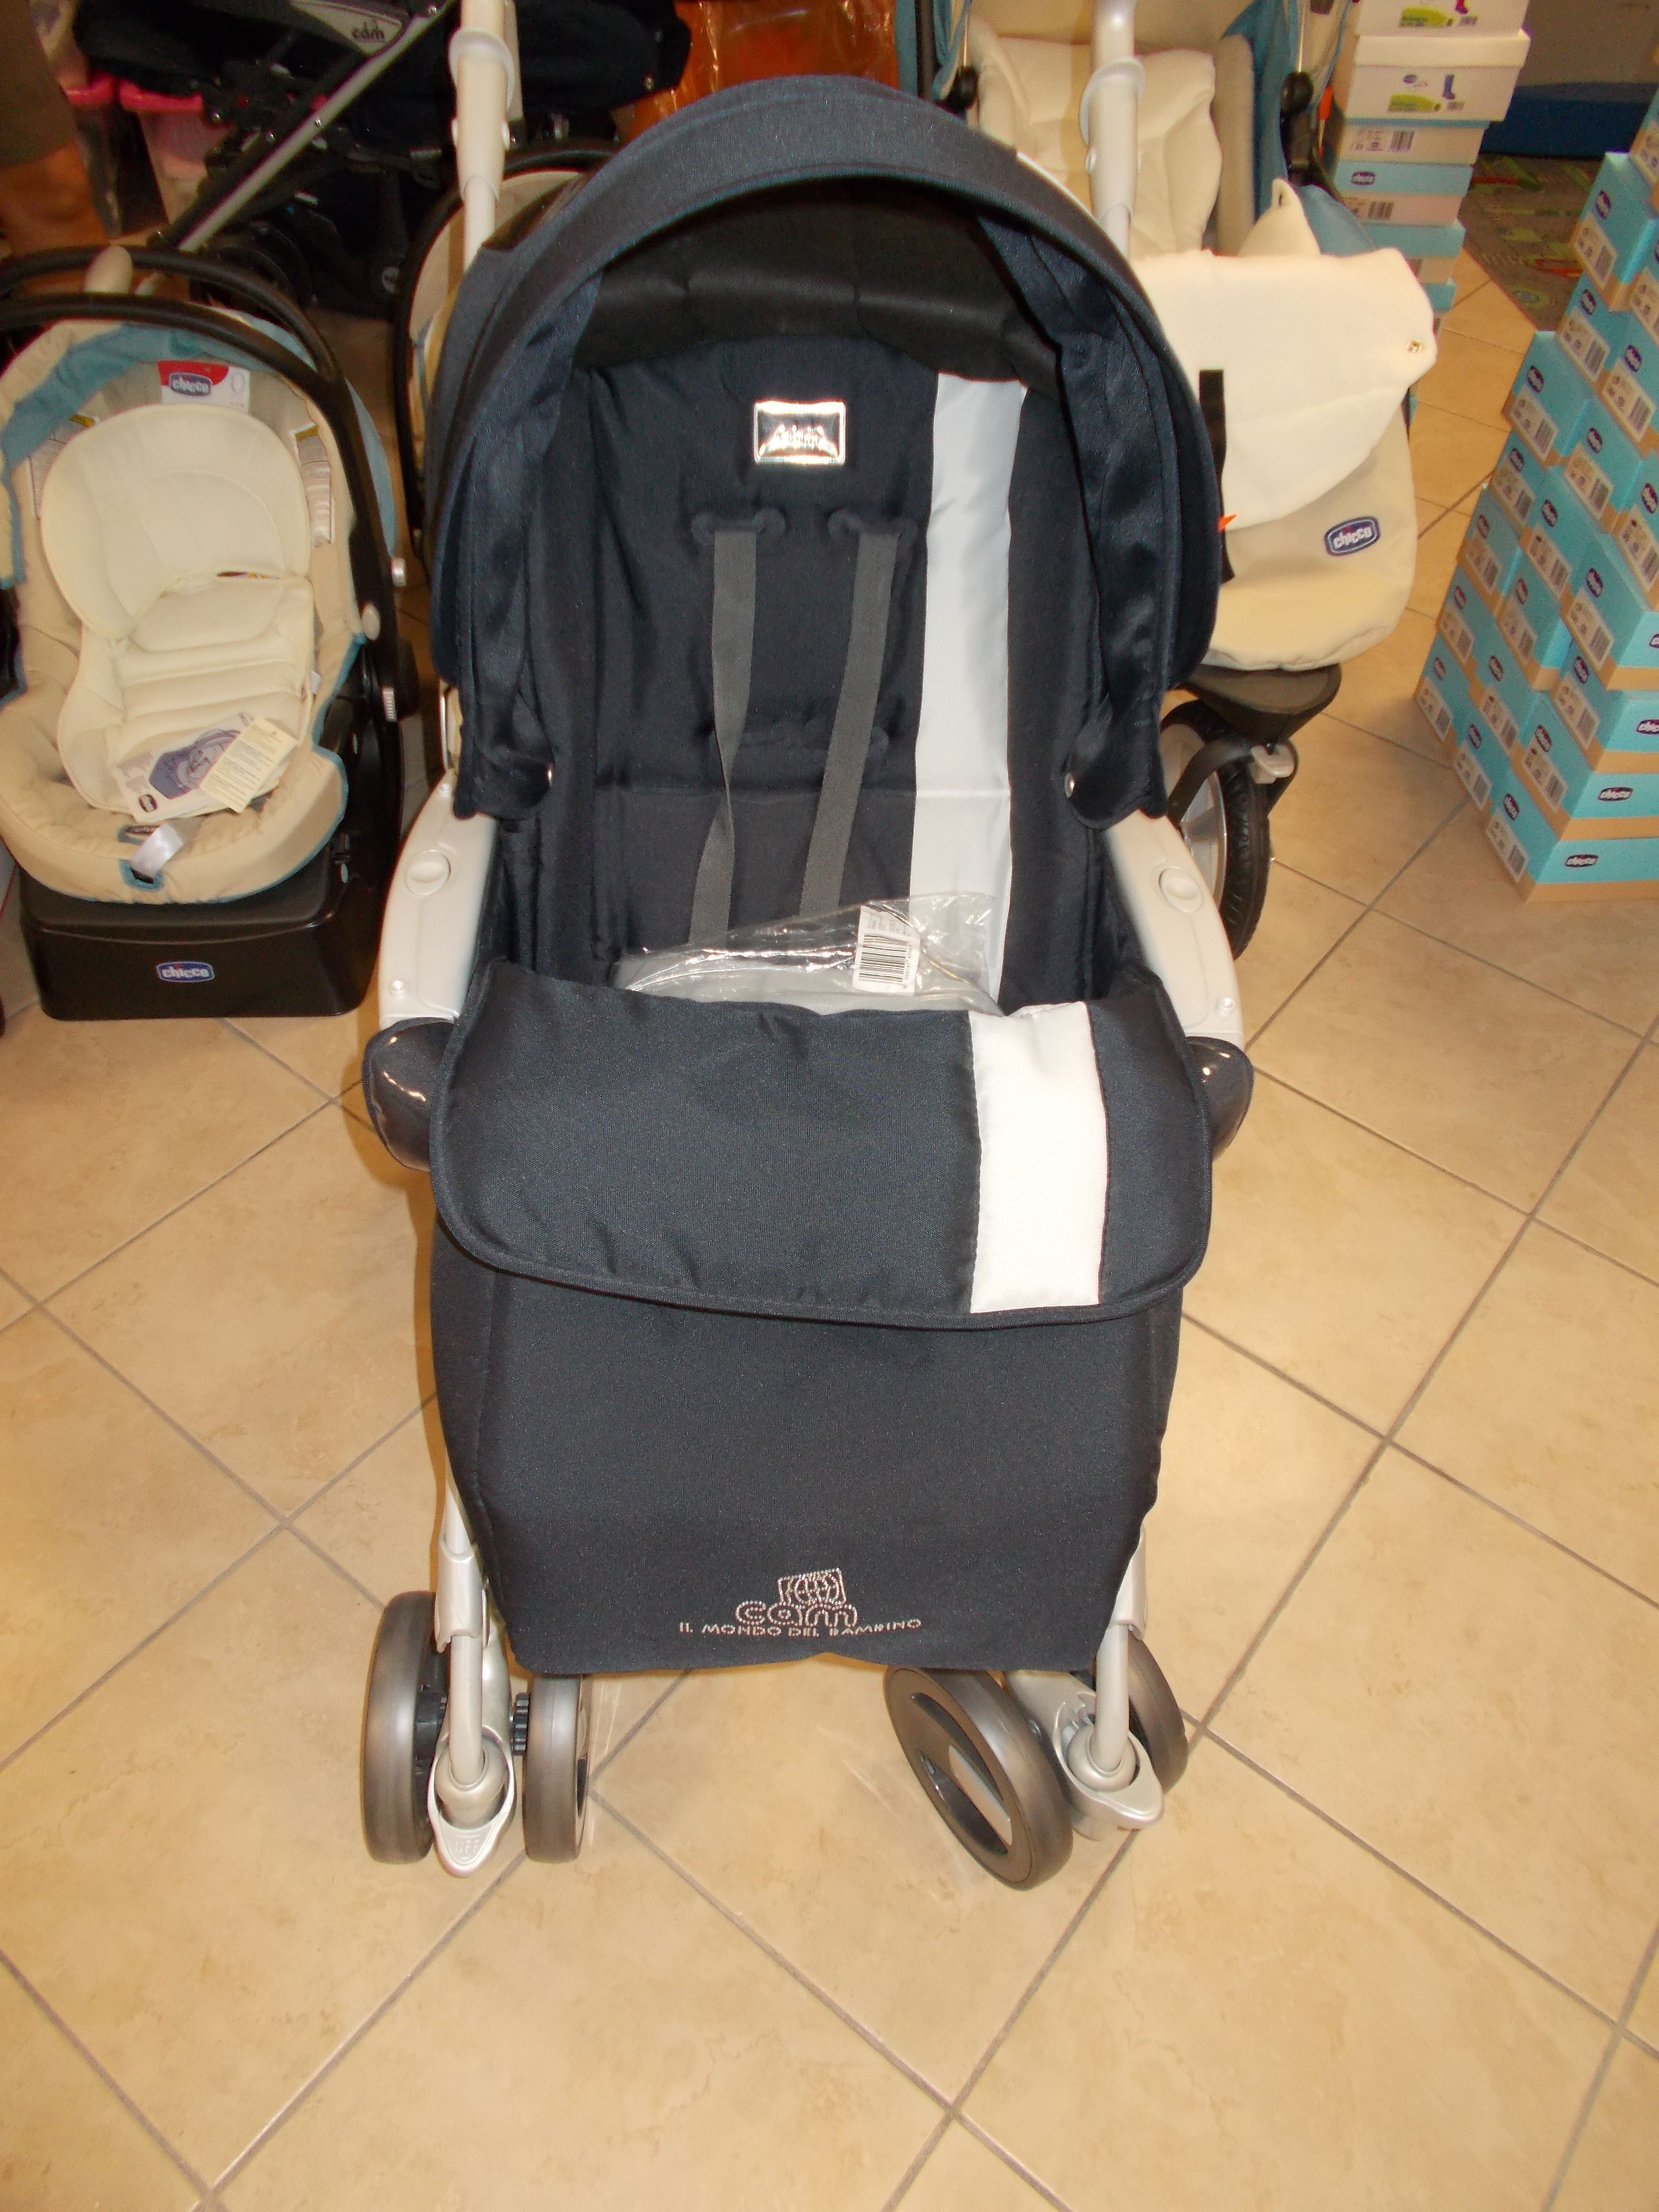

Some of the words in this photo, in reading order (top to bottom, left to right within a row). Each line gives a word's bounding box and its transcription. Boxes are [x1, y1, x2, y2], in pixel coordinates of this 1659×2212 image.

[172, 376, 209, 393] chicco
[1333, 526, 1372, 548] chicco
[161, 964, 210, 978] chicco
[735, 1600, 858, 1627] cam
[679, 1621, 694, 1634] IL
[701, 1623, 782, 1636] MONDO
[788, 1627, 820, 1637] DEL
[829, 1618, 922, 1636] BAMBINO
